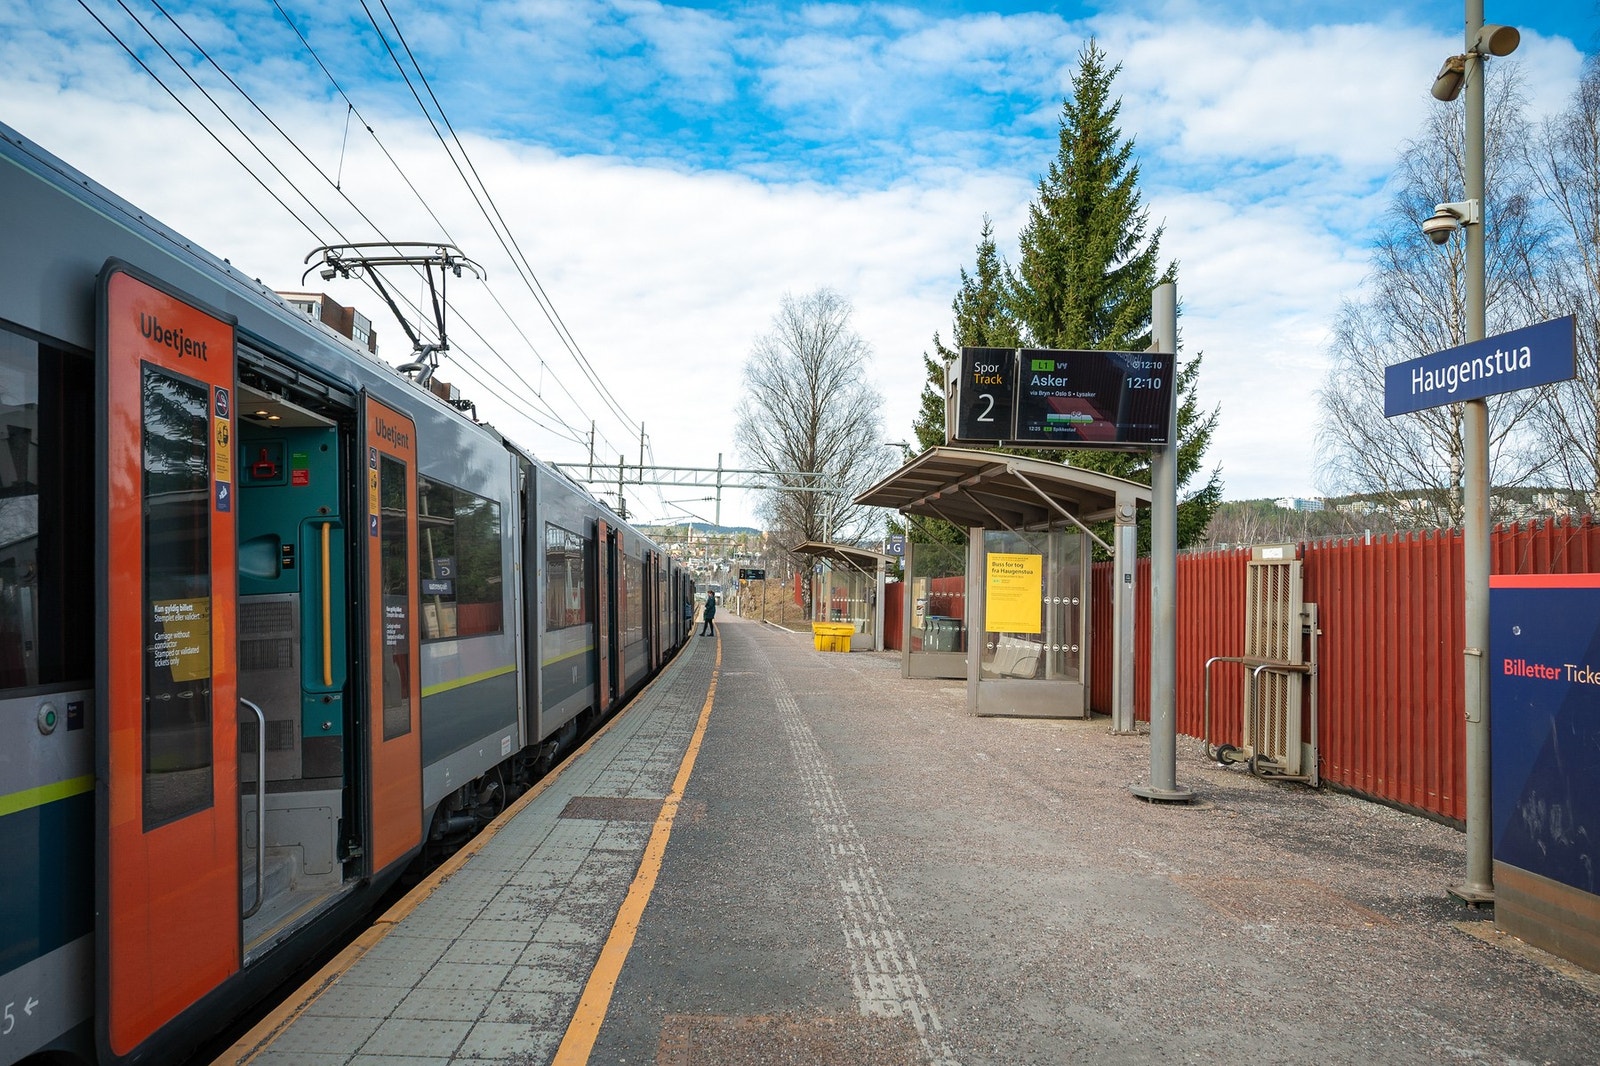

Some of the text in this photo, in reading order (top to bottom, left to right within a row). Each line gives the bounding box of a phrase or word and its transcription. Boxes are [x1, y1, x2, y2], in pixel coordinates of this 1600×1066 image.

[141, 312, 207, 362] Ubetjent
[974, 361, 999, 374] Spor
[1141, 361, 1162, 369] 12:10
[1411, 346, 1531, 394] Haugenstua
[974, 373, 1002, 385] Track
[1030, 374, 1068, 387] Asker
[1126, 377, 1162, 389] 12:10
[977, 394, 994, 422] 2
[375, 416, 409, 449] Ubetjent
[893, 543, 901, 553] G
[154, 649, 175, 658] Stamped
[180, 646, 199, 655] validated
[1503, 658, 1561, 680] Billetter
[3, 1002, 15, 1035] 5
